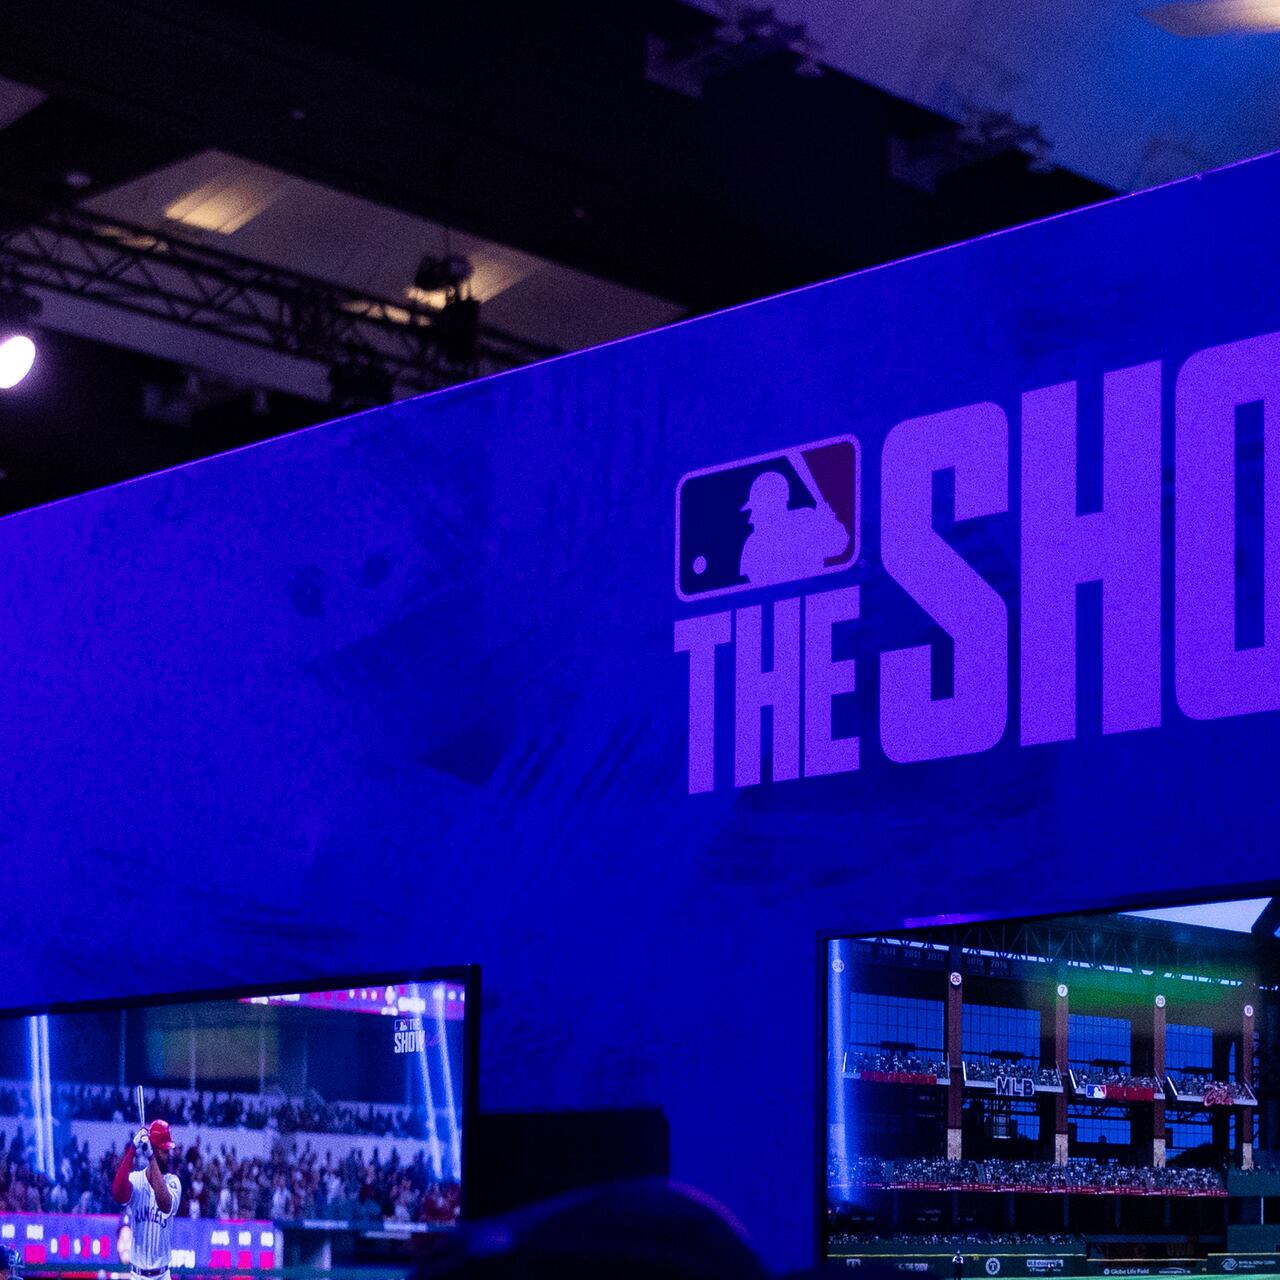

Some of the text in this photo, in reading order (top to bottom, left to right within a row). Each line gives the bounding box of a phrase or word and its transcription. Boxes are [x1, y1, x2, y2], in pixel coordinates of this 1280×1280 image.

[673, 584, 862, 796] THE
[394, 1031, 426, 1054] SHOW
[994, 1075, 1035, 1097] MLB
